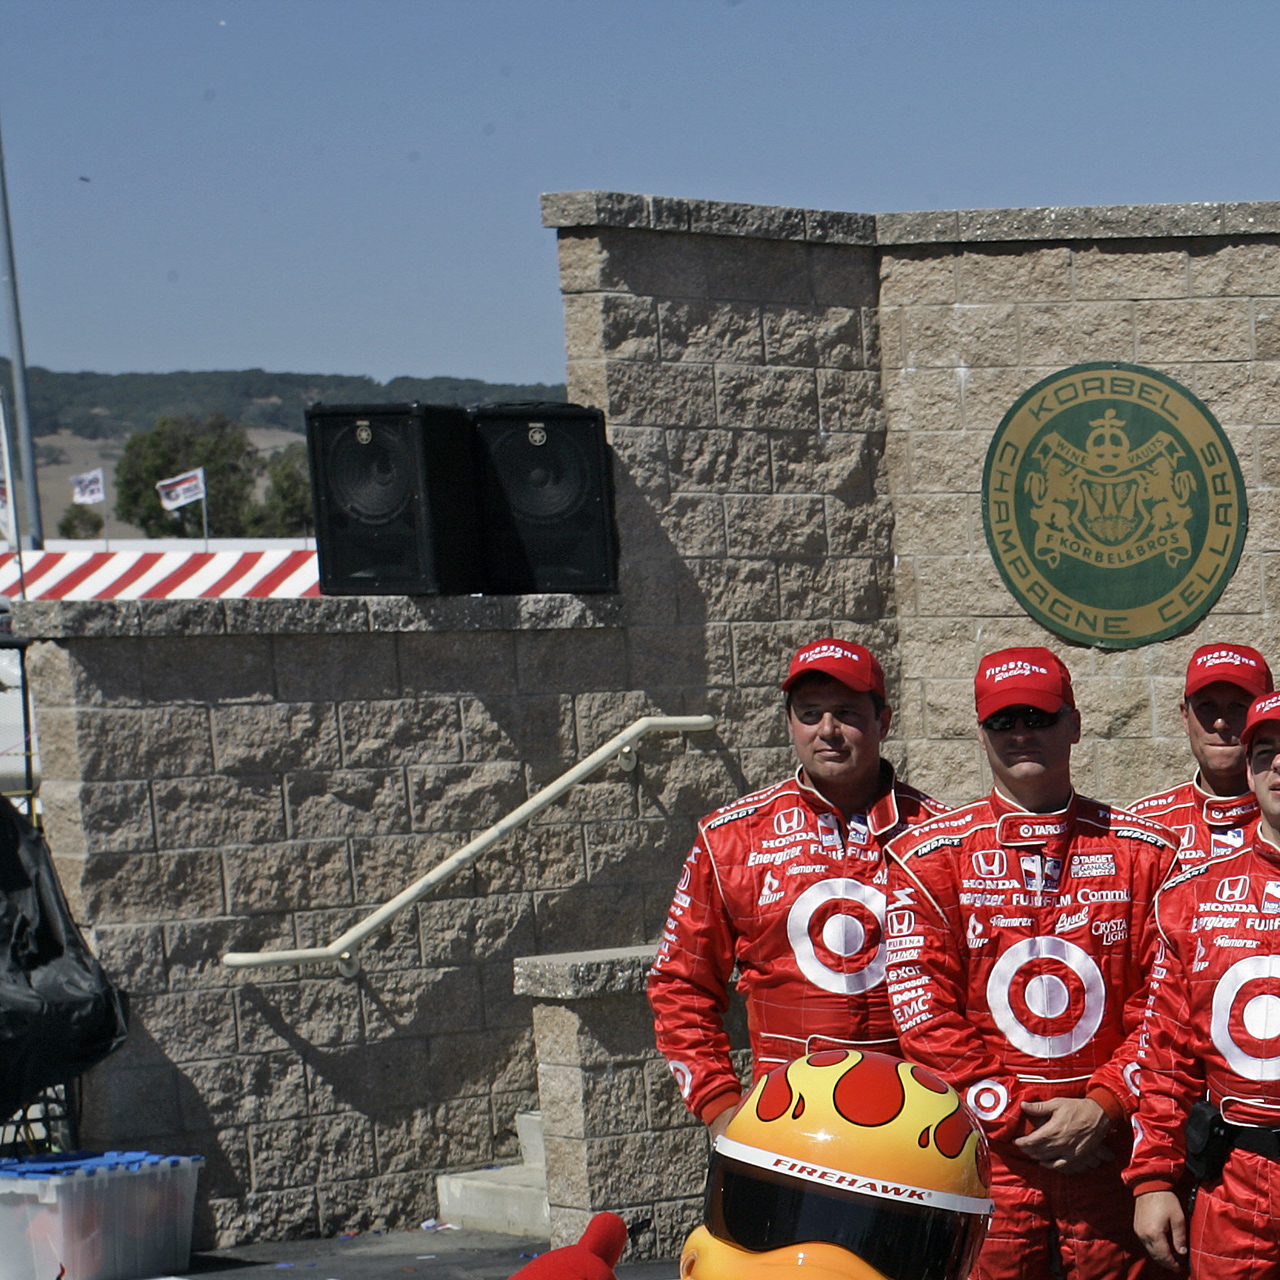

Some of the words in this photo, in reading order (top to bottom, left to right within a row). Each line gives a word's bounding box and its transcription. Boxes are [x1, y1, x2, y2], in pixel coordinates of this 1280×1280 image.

[1029, 376, 1179, 422] KORBEL
[1056, 438, 1088, 466] WINE
[1128, 436, 1164, 466] VAULTS
[992, 440, 1130, 635] CHAMPAGNE
[1136, 532, 1180, 560] BROS
[1157, 440, 1233, 624] CELLARS
[918, 839, 962, 856] IMPACT
[1117, 830, 1166, 848] IMPACT
[1080, 855, 1113, 864] TARGET
[963, 879, 1021, 889] HONDA
[1055, 907, 1089, 934] Lysol
[1091, 918, 1128, 936] CRYSTA
[772, 1156, 928, 1202] FIREHAWK
